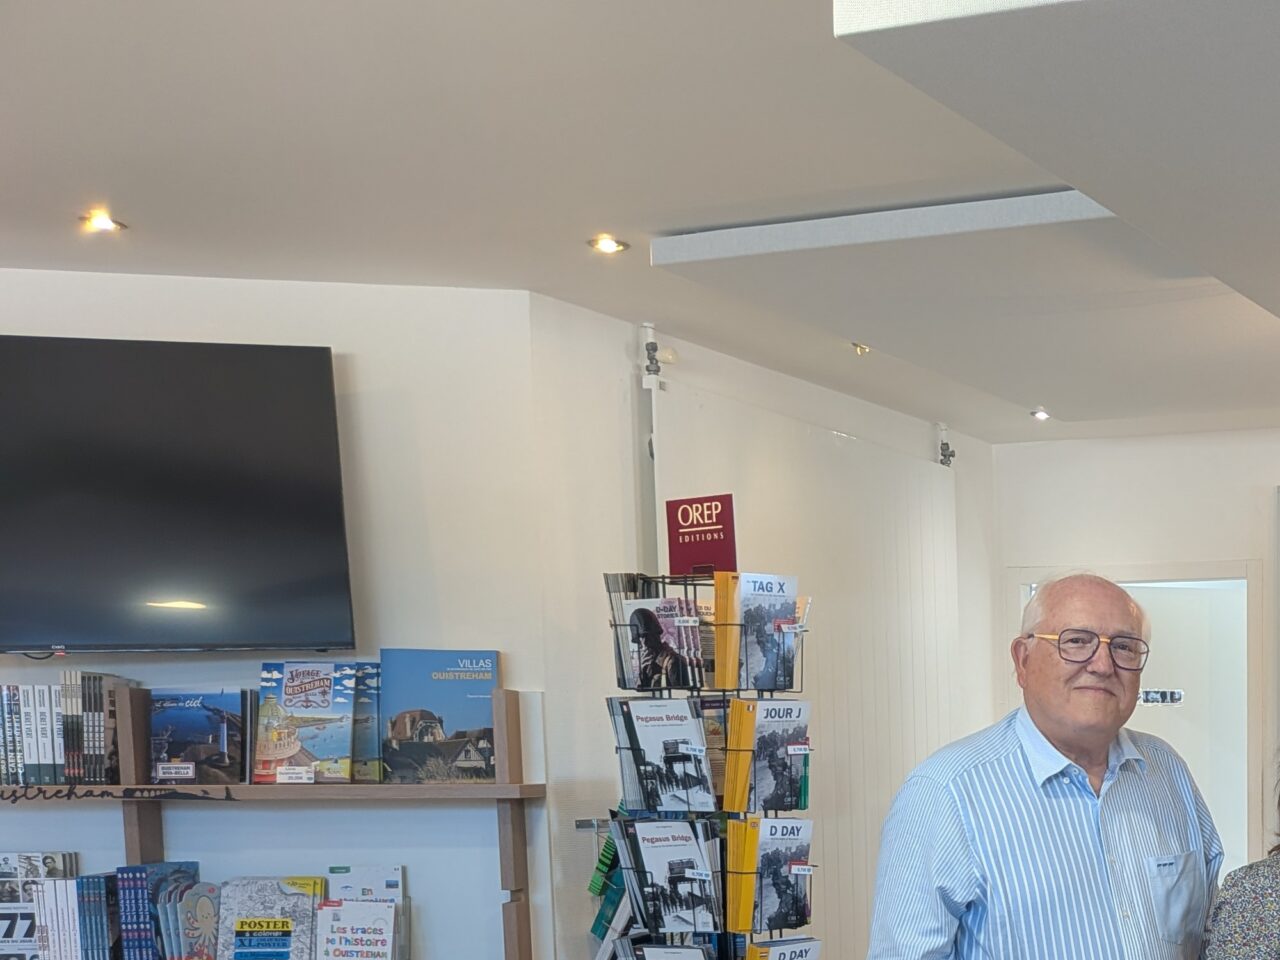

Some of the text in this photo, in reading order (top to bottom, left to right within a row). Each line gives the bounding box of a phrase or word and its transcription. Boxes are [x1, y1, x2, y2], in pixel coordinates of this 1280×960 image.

[677, 501, 722, 527] OREP
[679, 531, 725, 544] EDITIONS
[752, 580, 785, 593] TAG X
[458, 659, 492, 668] VILLAS
[432, 671, 492, 680] OUISTREHAM
[636, 714, 688, 723] Pegasus Bridge
[763, 708, 802, 719] JOUR J
[0, 784, 114, 803] istreham
[770, 825, 802, 837] D DAY
[641, 834, 692, 844] Pegasus Bridge
[361, 888, 373, 896] En
[240, 920, 290, 929] POSTER
[330, 924, 384, 935] Les traces
[239, 939, 256, 947] XL
[339, 936, 387, 947] l'histoire
[789, 948, 811, 960] DAY
